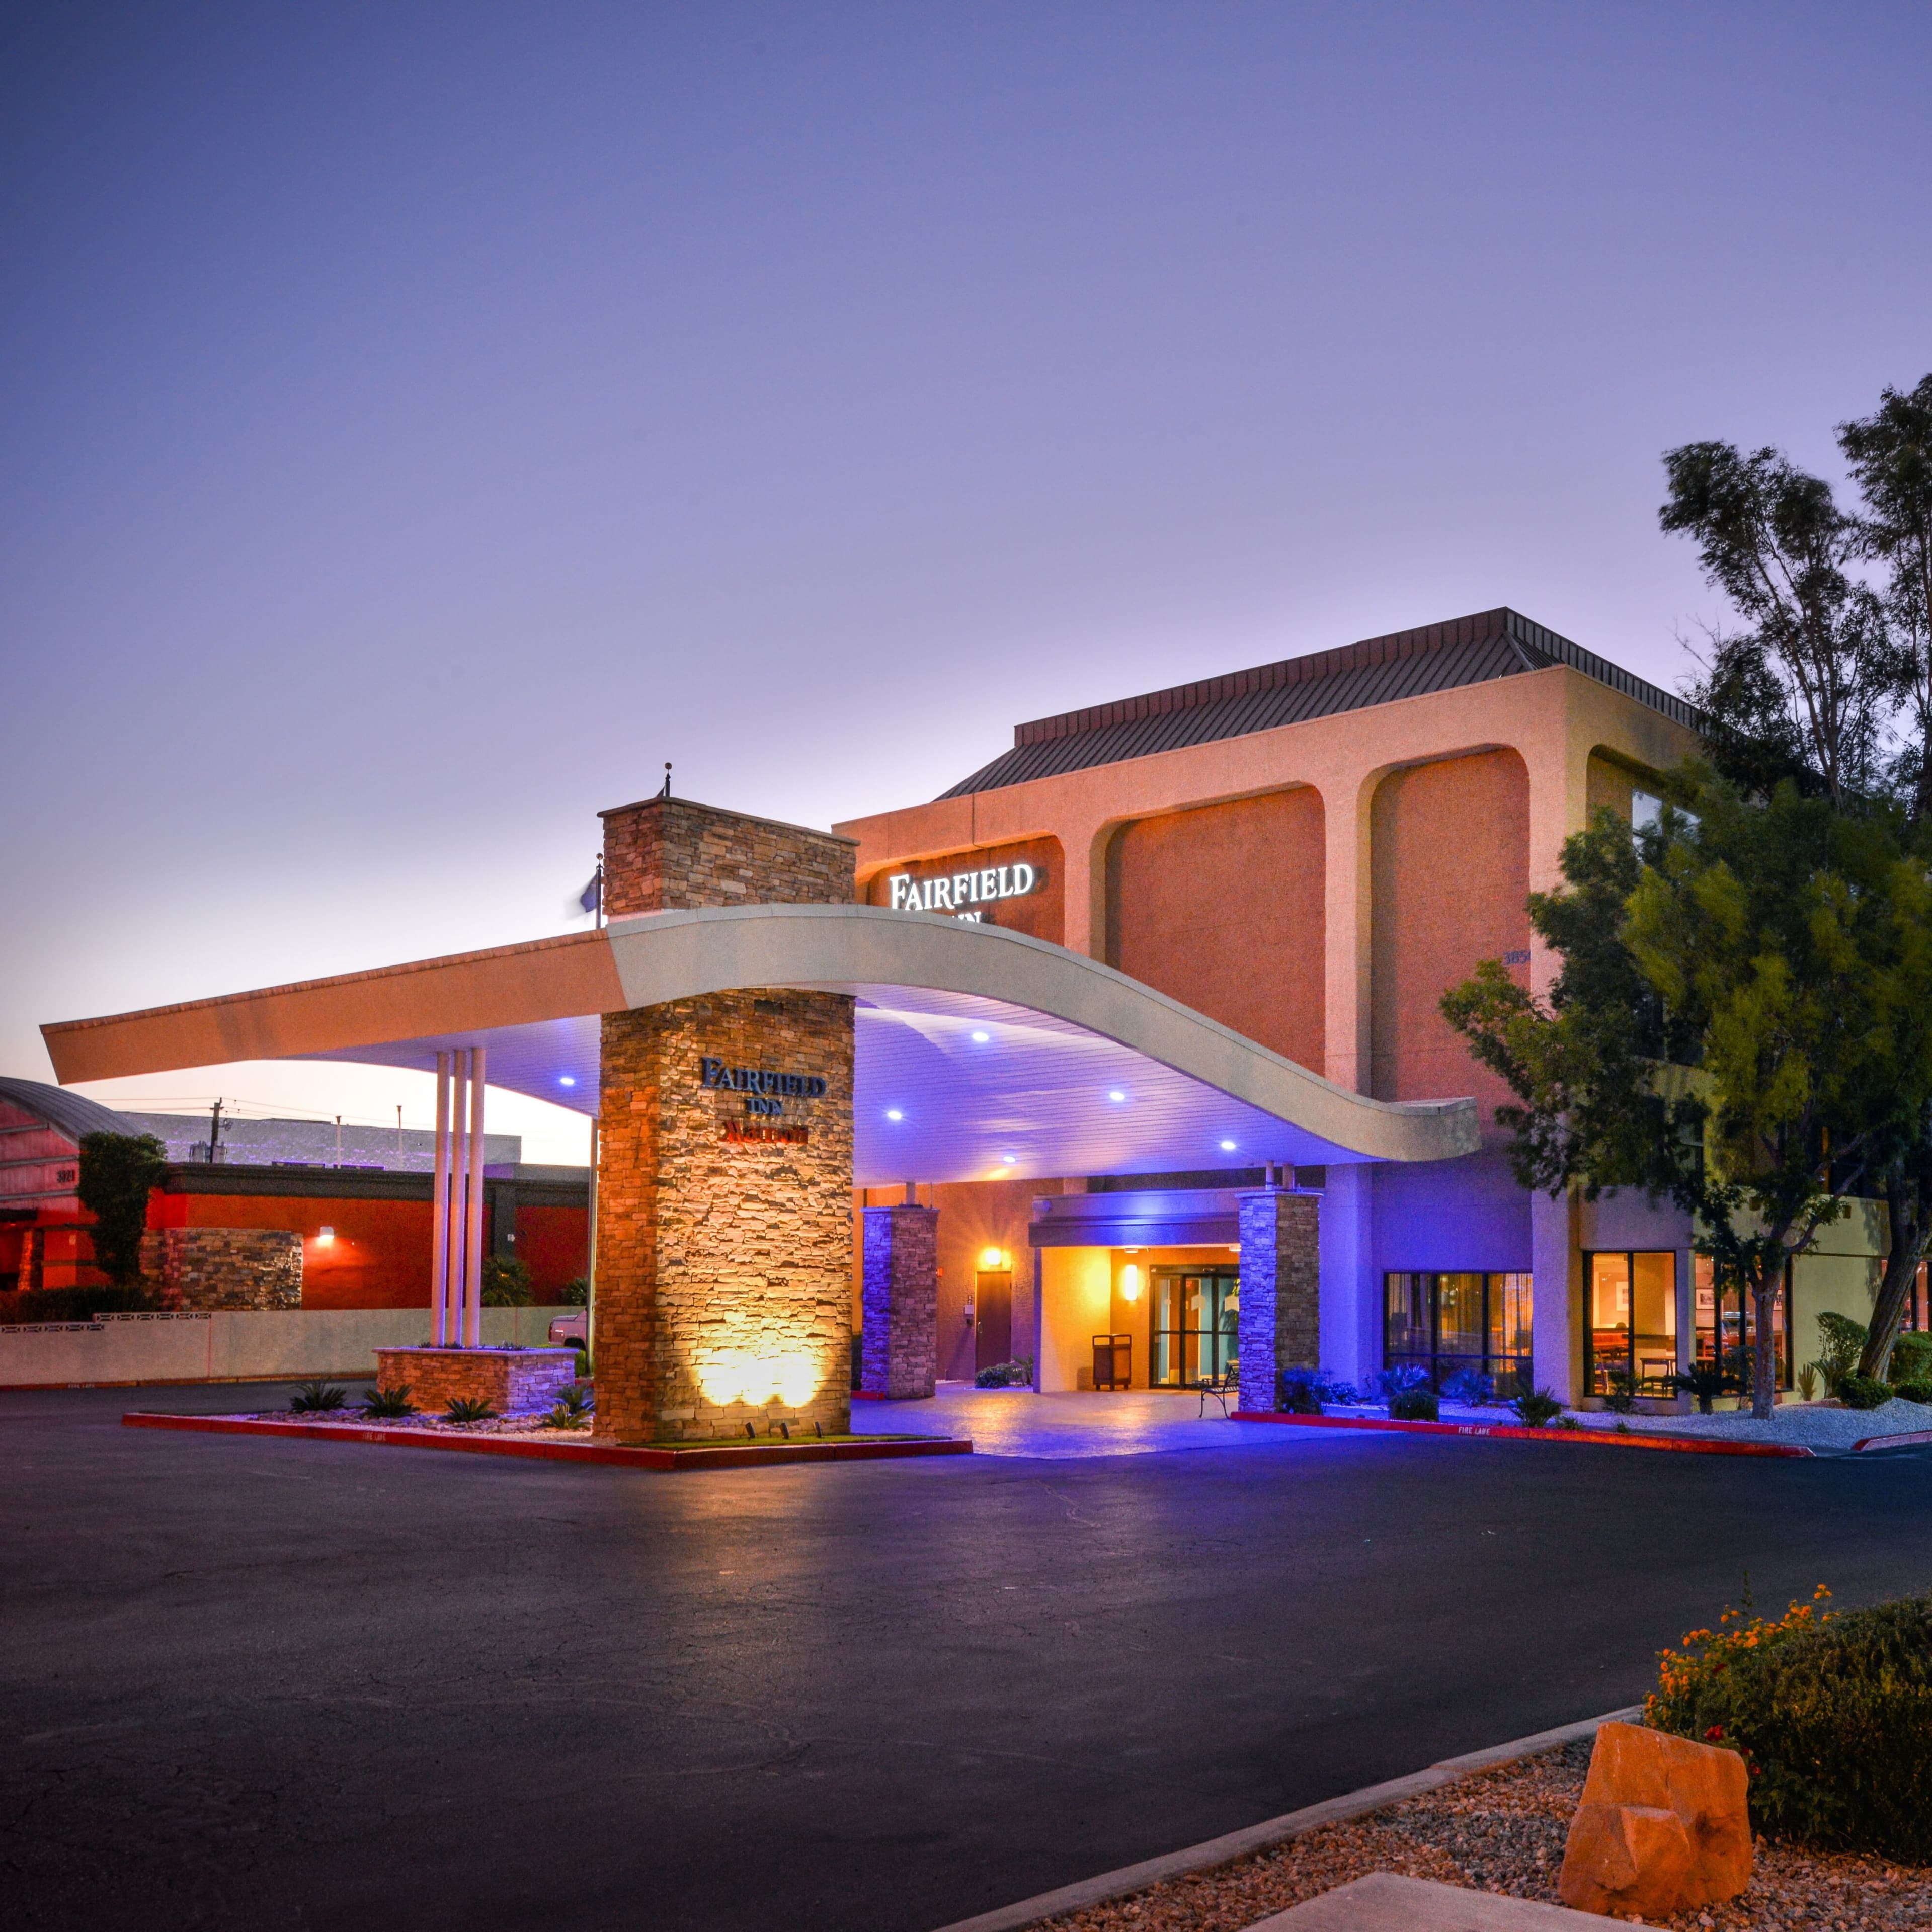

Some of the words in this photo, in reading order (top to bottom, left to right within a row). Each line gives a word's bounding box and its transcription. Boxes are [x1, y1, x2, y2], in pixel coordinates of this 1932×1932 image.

[889, 863, 1034, 911] FAIRFIELD
[702, 1057, 827, 1097] FAIRFIELD
[746, 1098, 784, 1115] INN
[1474, 1427, 1490, 1435] LANE
